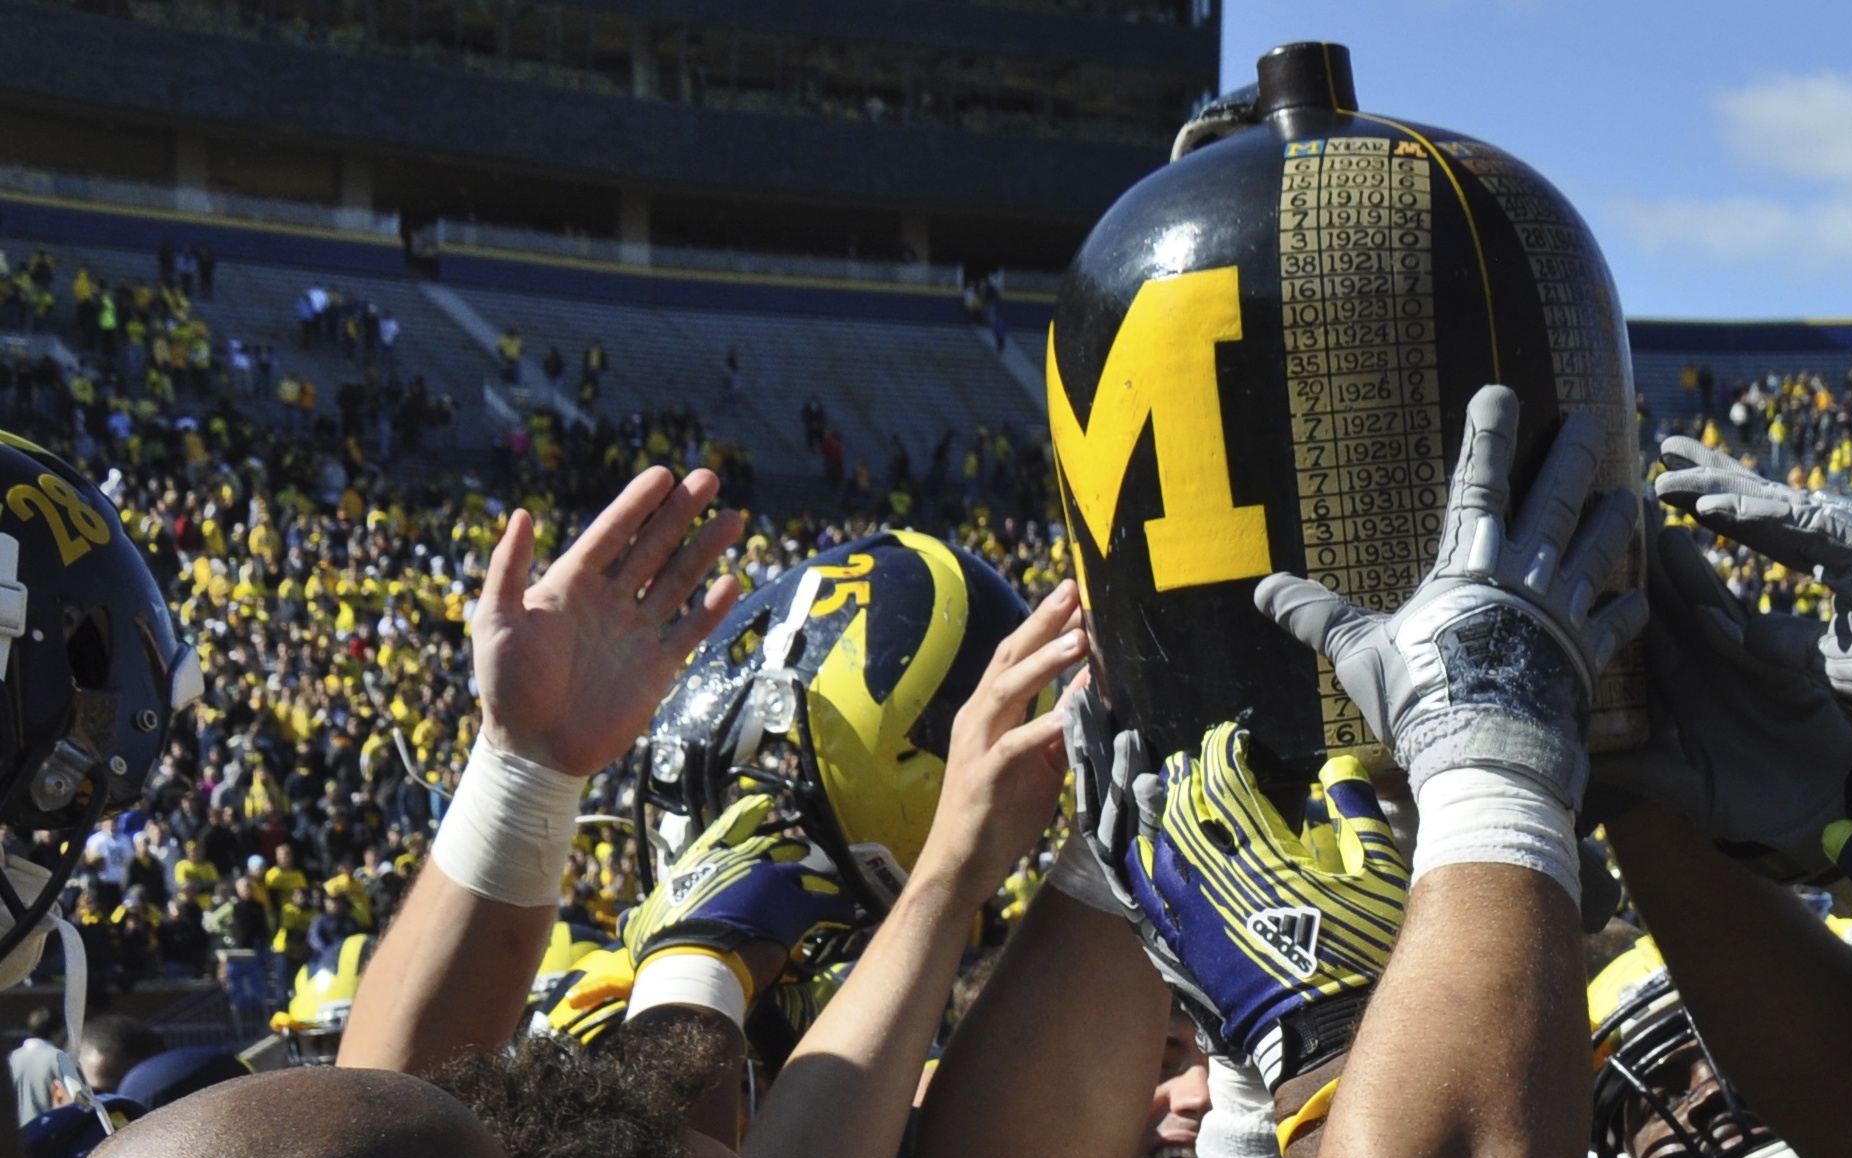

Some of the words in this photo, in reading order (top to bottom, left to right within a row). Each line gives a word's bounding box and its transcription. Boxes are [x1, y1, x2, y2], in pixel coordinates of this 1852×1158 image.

[1330, 142, 1383, 151] YEAR
[1295, 159, 1311, 172] 6
[1328, 158, 1385, 171] 1903
[1398, 160, 1414, 172] 6
[1288, 175, 1311, 190] 15
[1326, 173, 1384, 188] 1909
[1399, 176, 1415, 189] 6
[1290, 192, 1308, 207] 6
[1325, 189, 1385, 207] 1910
[1399, 192, 1417, 207] 0
[1292, 210, 1308, 229] 7
[1325, 209, 1382, 227] 1919
[1394, 211, 1424, 229] 34
[1291, 232, 1307, 250] 3
[1326, 230, 1387, 249] 1920
[1399, 231, 1419, 247] 0
[1521, 227, 1547, 249] 28
[1285, 255, 1316, 274] 38
[1328, 252, 1386, 273] 1921
[1401, 253, 1419, 270] 0
[1289, 280, 1316, 299] 16
[1328, 276, 1389, 297] 1922
[1403, 276, 1419, 293] 7
[1290, 304, 1319, 326] 10
[1331, 299, 1388, 322] 1923
[1402, 299, 1422, 316] 0
[1290, 329, 1318, 349] 13
[1333, 324, 1389, 347] 1924
[1405, 322, 1424, 340] 0
[1290, 355, 1320, 375] 35
[1335, 351, 1388, 371] 1925
[1406, 348, 1424, 365] 0
[1297, 380, 1323, 396] 20
[1338, 377, 1391, 403] 1926
[1408, 370, 1424, 386] 0
[1305, 397, 1320, 411] 7
[1411, 385, 1424, 402] 6
[1563, 380, 1574, 398] 7
[1046, 265, 1273, 611] M
[1304, 418, 1322, 441] 7
[1342, 412, 1398, 436] 1927
[1409, 410, 1432, 430] 13
[1307, 446, 1325, 467] 7
[1344, 439, 1401, 463] 1929
[1415, 436, 1432, 457] 6
[1309, 473, 1328, 494] 7
[1347, 466, 1407, 490] 1930
[1415, 462, 1435, 482] 0
[1313, 498, 1330, 518] 6
[1350, 490, 1406, 514] 1931
[1418, 487, 1437, 507] 0
[6, 472, 111, 567] 28
[1316, 523, 1334, 541] 3
[1352, 515, 1411, 541] 1932
[1421, 513, 1440, 533] 0
[1318, 547, 1336, 566] 0
[1354, 541, 1411, 564] 1933
[805, 553, 875, 618] 25
[1319, 573, 1340, 591] 0
[1356, 565, 1414, 590] 1934
[1334, 697, 1350, 717] 7
[1336, 724, 1355, 745] 6
[1252, 919, 1313, 974] adidas
